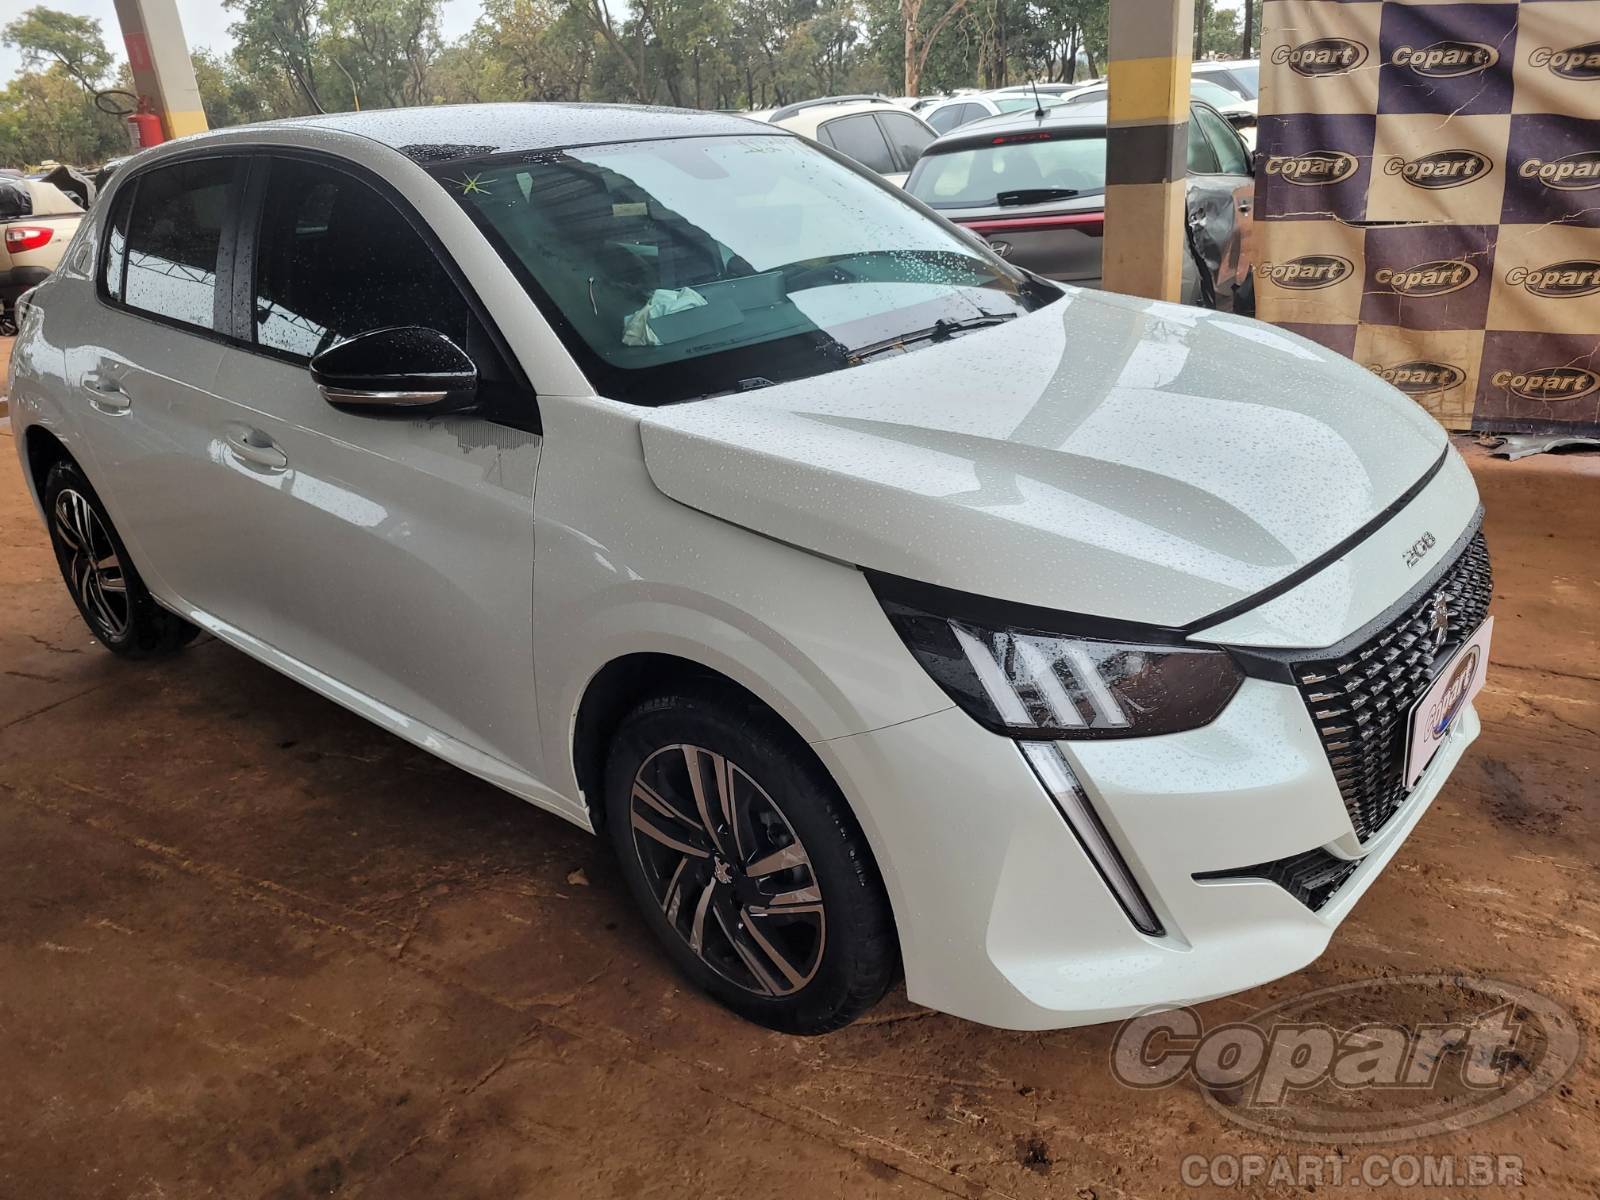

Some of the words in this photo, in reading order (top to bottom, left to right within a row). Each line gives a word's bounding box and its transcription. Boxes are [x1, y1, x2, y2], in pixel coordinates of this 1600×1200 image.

[1271, 44, 1354, 70] Copart
[1391, 45, 1487, 70] Copart
[1528, 46, 1600, 71] Copa
[1265, 155, 1347, 178] Copart
[1384, 156, 1477, 180] Copart
[1518, 158, 1600, 183] Copar
[1258, 261, 1339, 282] Copart
[1375, 266, 1464, 289] Copart
[1491, 370, 1588, 393] Copart
[1402, 530, 1436, 568] 208
